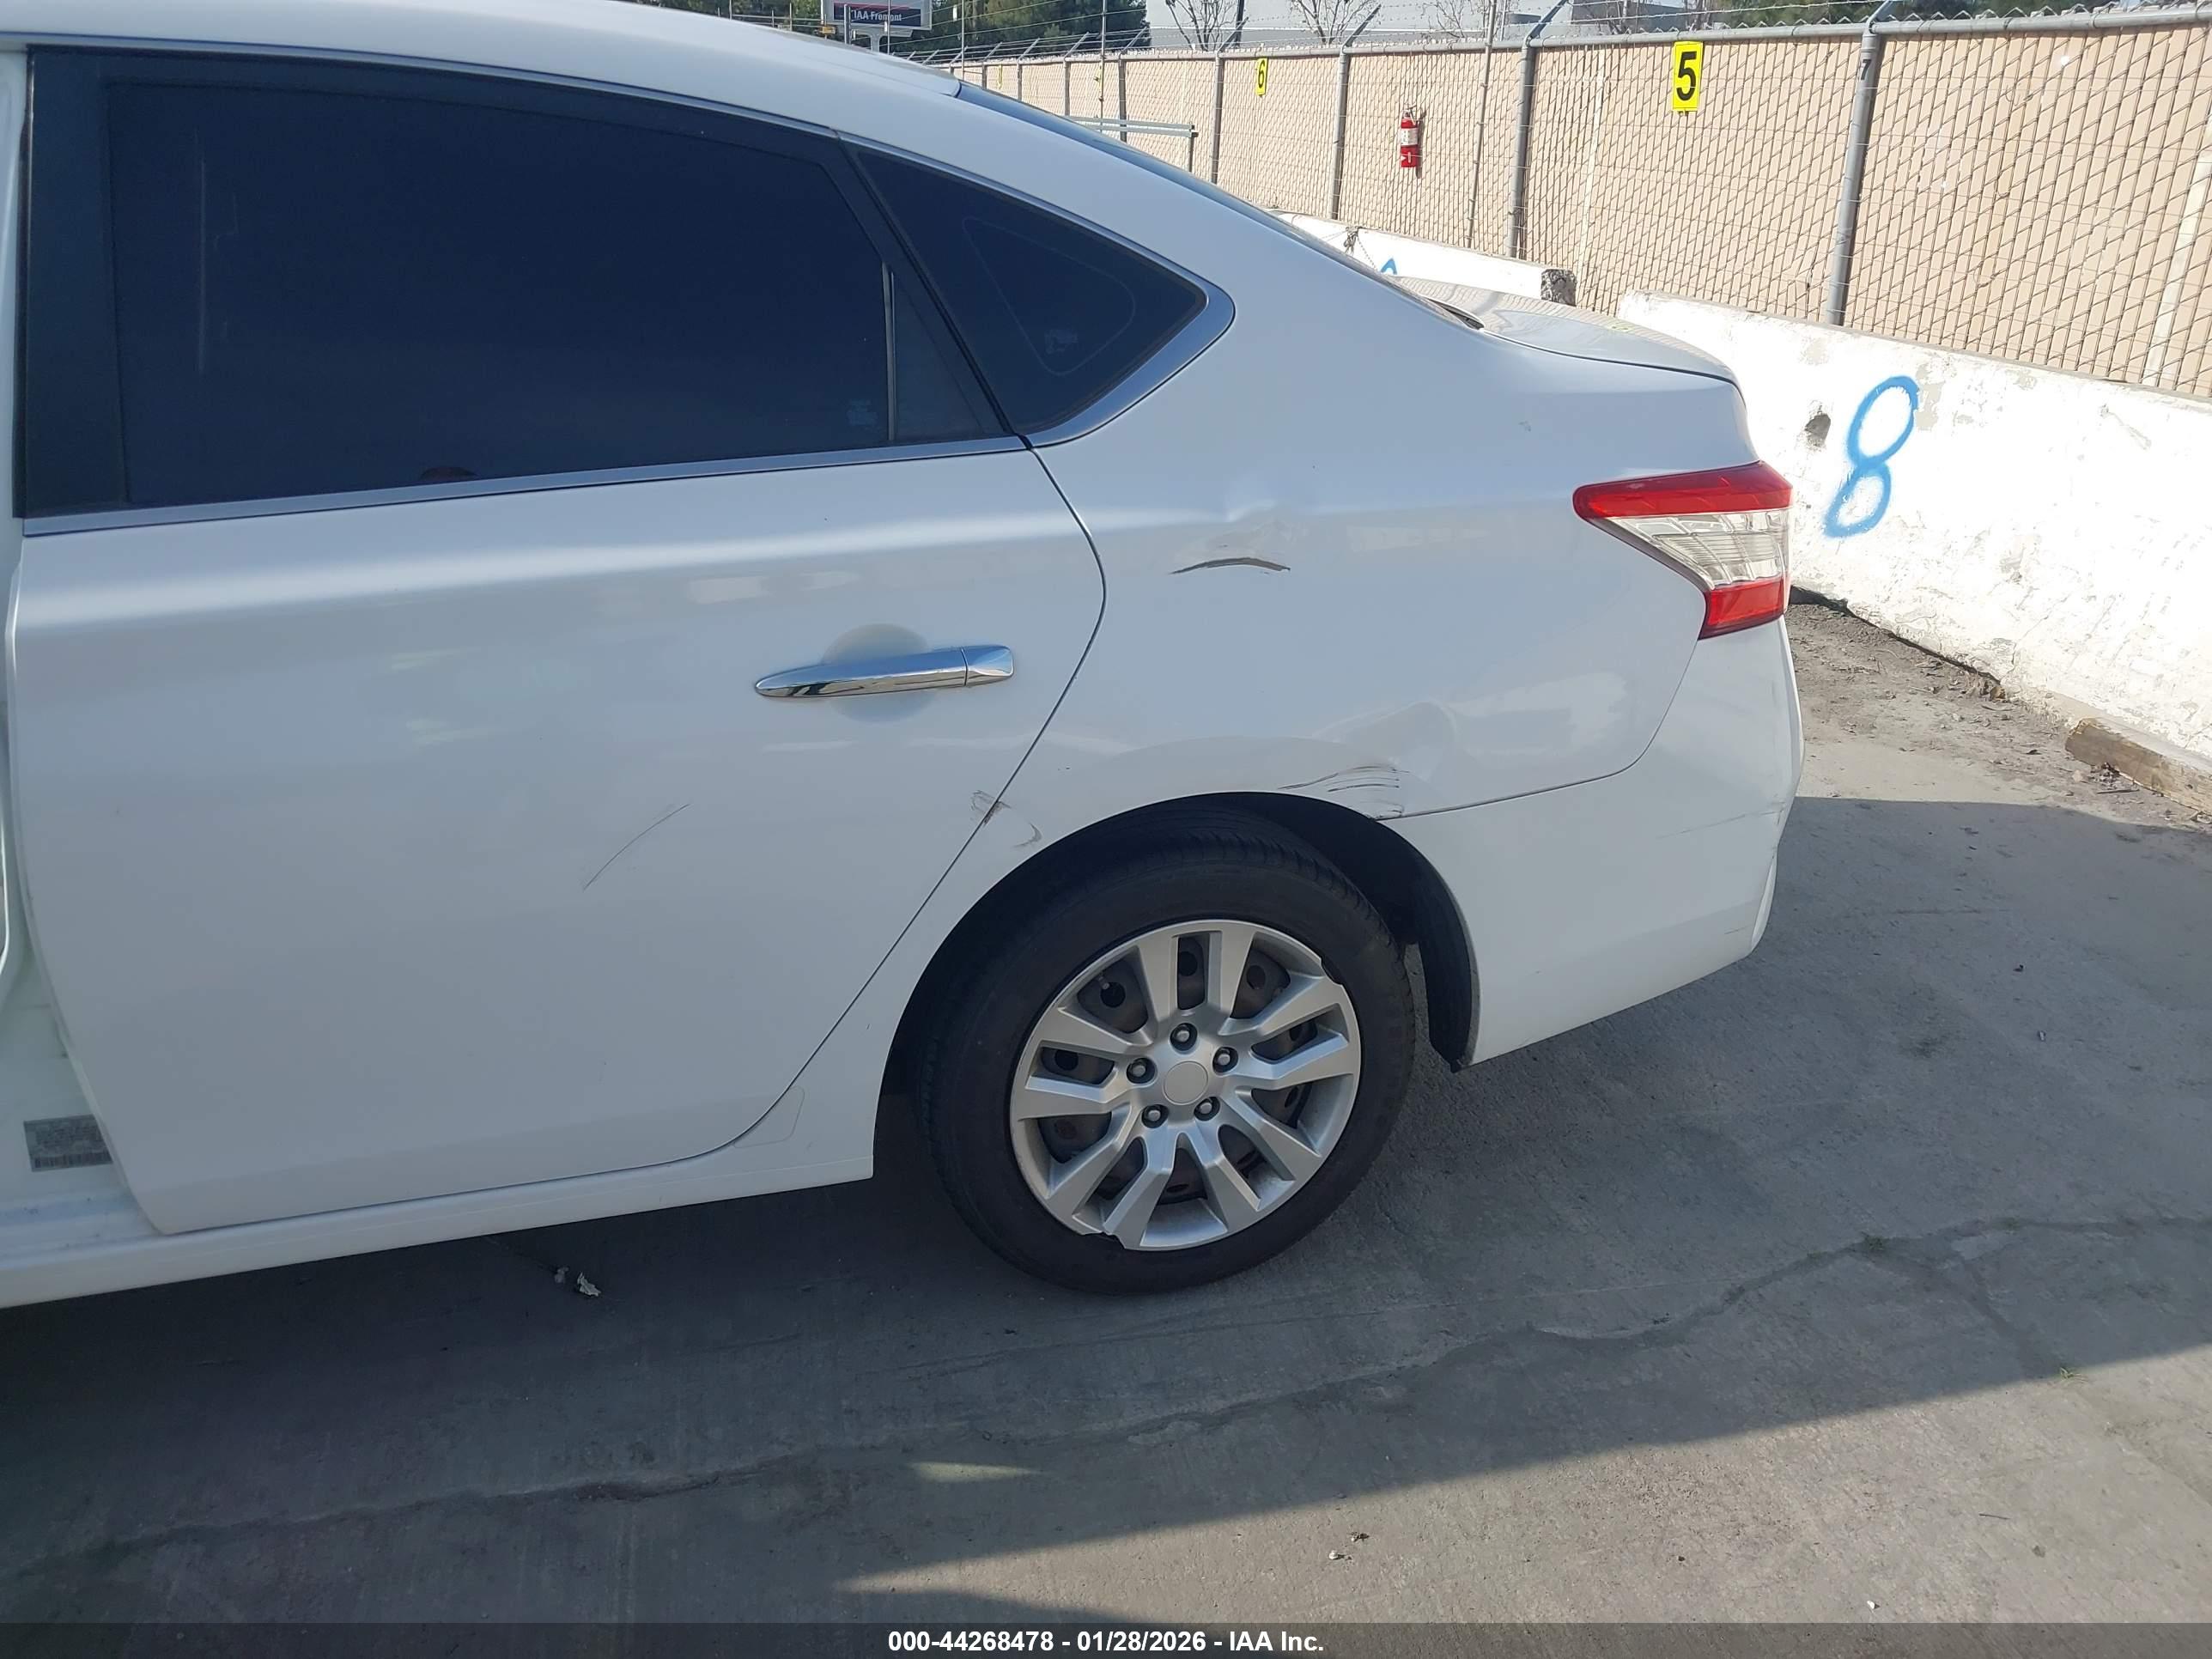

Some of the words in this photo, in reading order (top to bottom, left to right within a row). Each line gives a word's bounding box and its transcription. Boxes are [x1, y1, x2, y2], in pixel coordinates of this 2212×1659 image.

[854, 9, 869, 20] IAA
[871, 11, 902, 21] Fremont
[1258, 59, 1266, 89] 6
[1676, 51, 1698, 101] 5
[1822, 375, 1920, 538] 8
